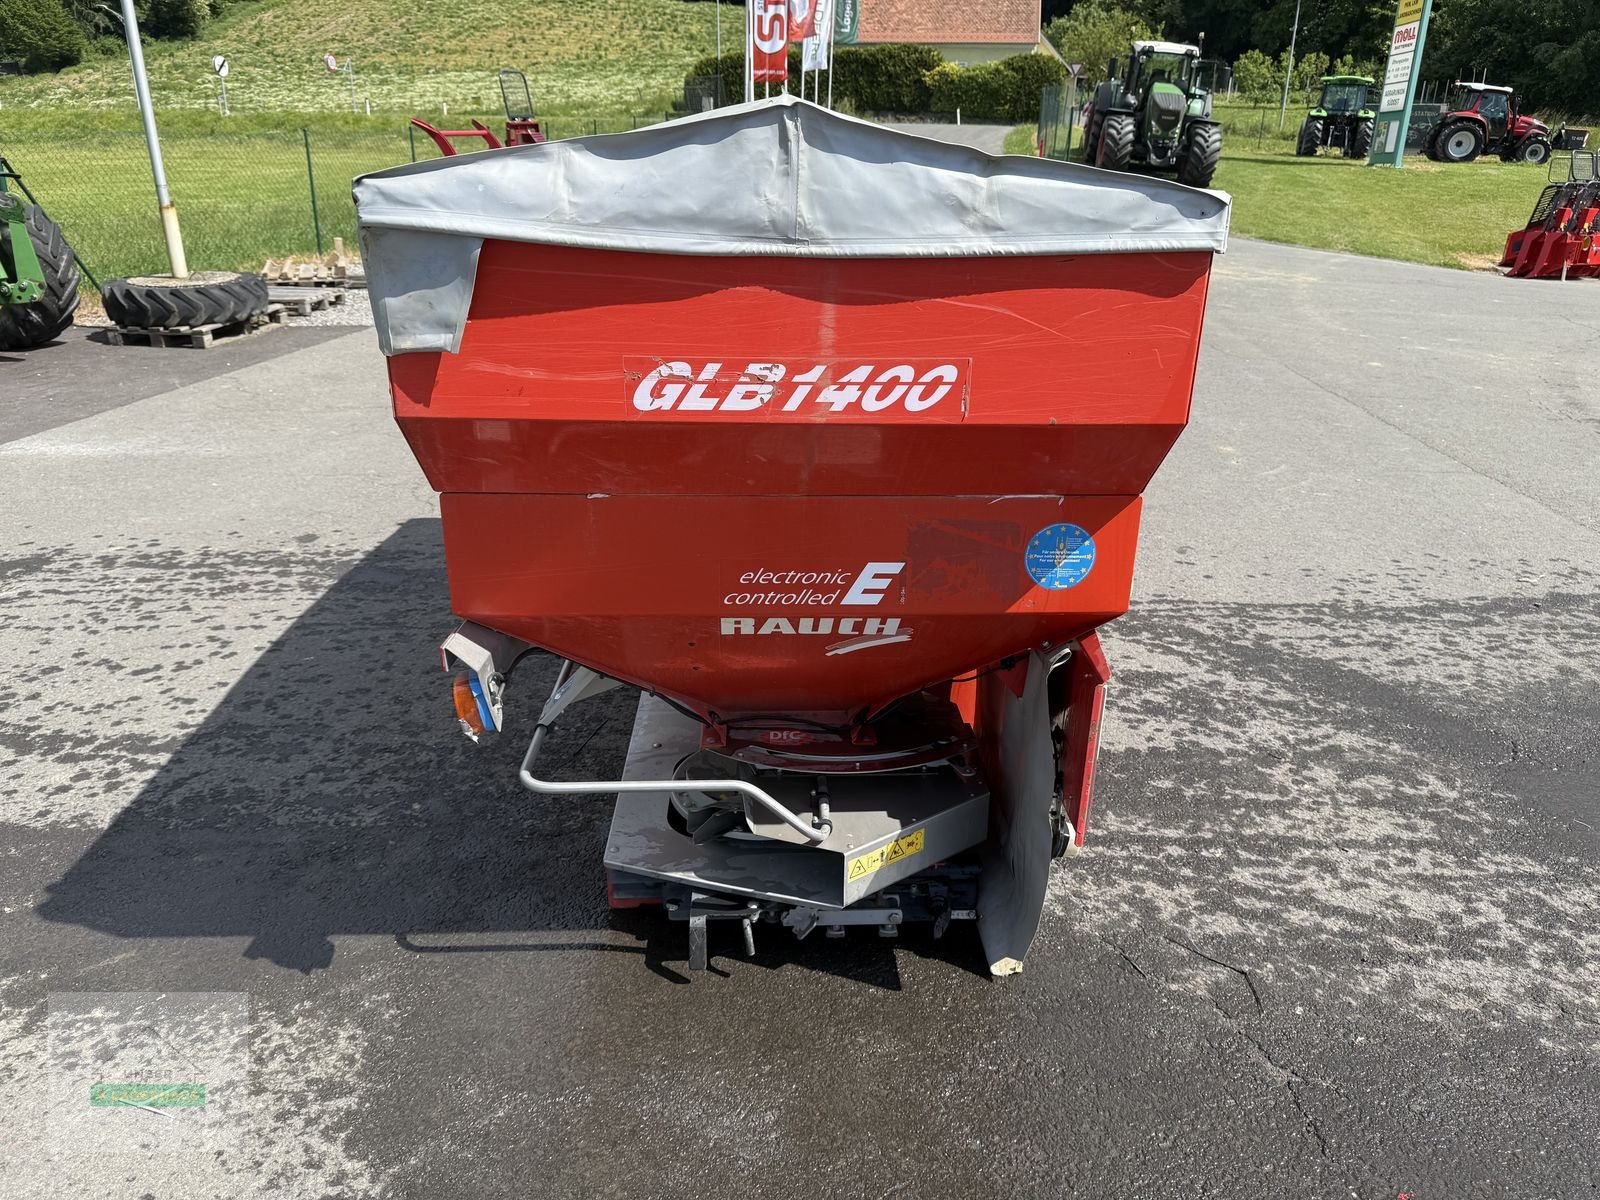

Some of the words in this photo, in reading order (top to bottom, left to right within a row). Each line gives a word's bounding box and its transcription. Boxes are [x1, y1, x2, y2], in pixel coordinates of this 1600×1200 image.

[739, 568, 851, 584] electronic
[840, 562, 905, 605] E
[723, 589, 840, 605] controlled
[720, 618, 901, 636] RAUCH
